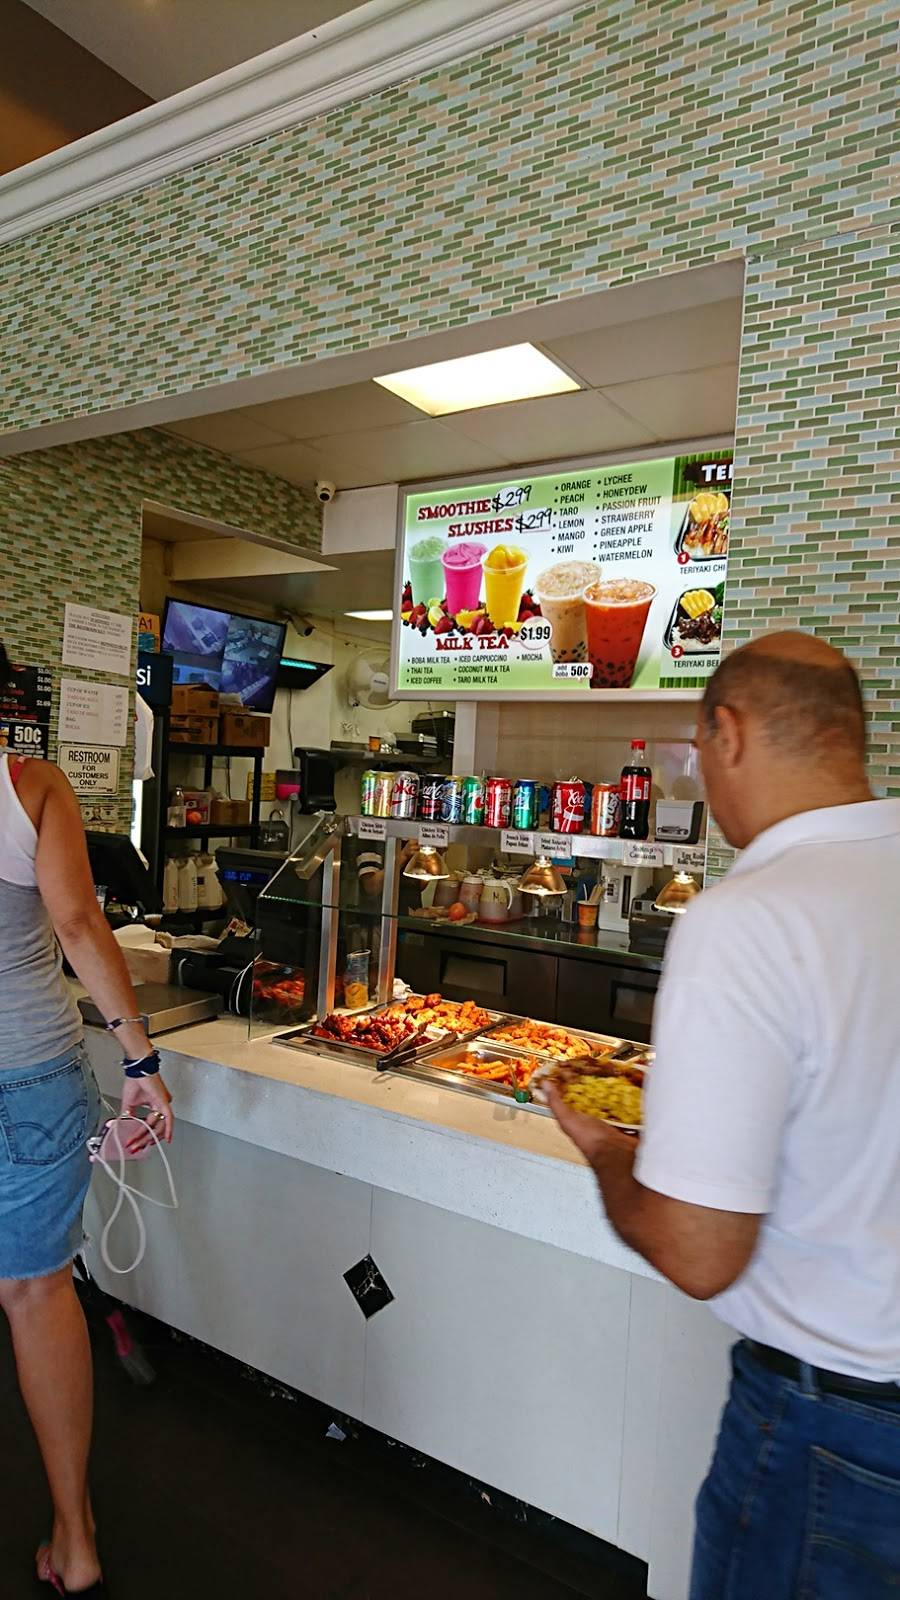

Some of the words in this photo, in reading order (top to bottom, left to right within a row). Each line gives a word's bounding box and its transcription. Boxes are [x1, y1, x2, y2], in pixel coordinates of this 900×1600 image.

[561, 479, 592, 492] ORANGE
[604, 473, 633, 486] LYCHEE
[602, 485, 648, 499] HONEYDEW
[560, 493, 585, 504] PEACH
[602, 501, 636, 512] PASSION
[638, 496, 662, 507] FRUIT
[418, 499, 492, 521] SMOOTHIE
[560, 506, 579, 517] TARO
[601, 510, 656, 525] STRAWBERRY
[448, 518, 515, 538] SLUSHES
[558, 518, 585, 530] LEMON
[557, 530, 585, 542] MANGO
[600, 525, 627, 538] GREEN
[627, 523, 654, 535] APPLE
[556, 544, 574, 554] KIWI
[599, 537, 643, 550] PINEAPPLE
[598, 549, 654, 562] WATERMELON
[680, 565, 711, 575] TERIYAKI
[138, 617, 152, 630] A1
[520, 626, 551, 641] $1.99
[435, 637, 474, 651] MILK
[477, 635, 510, 650] TEA
[428, 656, 443, 664] MILK
[458, 655, 471, 663] ICED
[472, 654, 508, 662] CAPPUCCINO
[521, 653, 543, 661] MOCHA
[458, 665, 483, 673] COCONUT
[674, 660, 705, 668] TERIYAKI
[571, 665, 589, 676] 50¢
[472, 676, 486, 684] MILK
[14, 725, 42, 743] 50¢
[68, 751, 110, 763] RESTROOM
